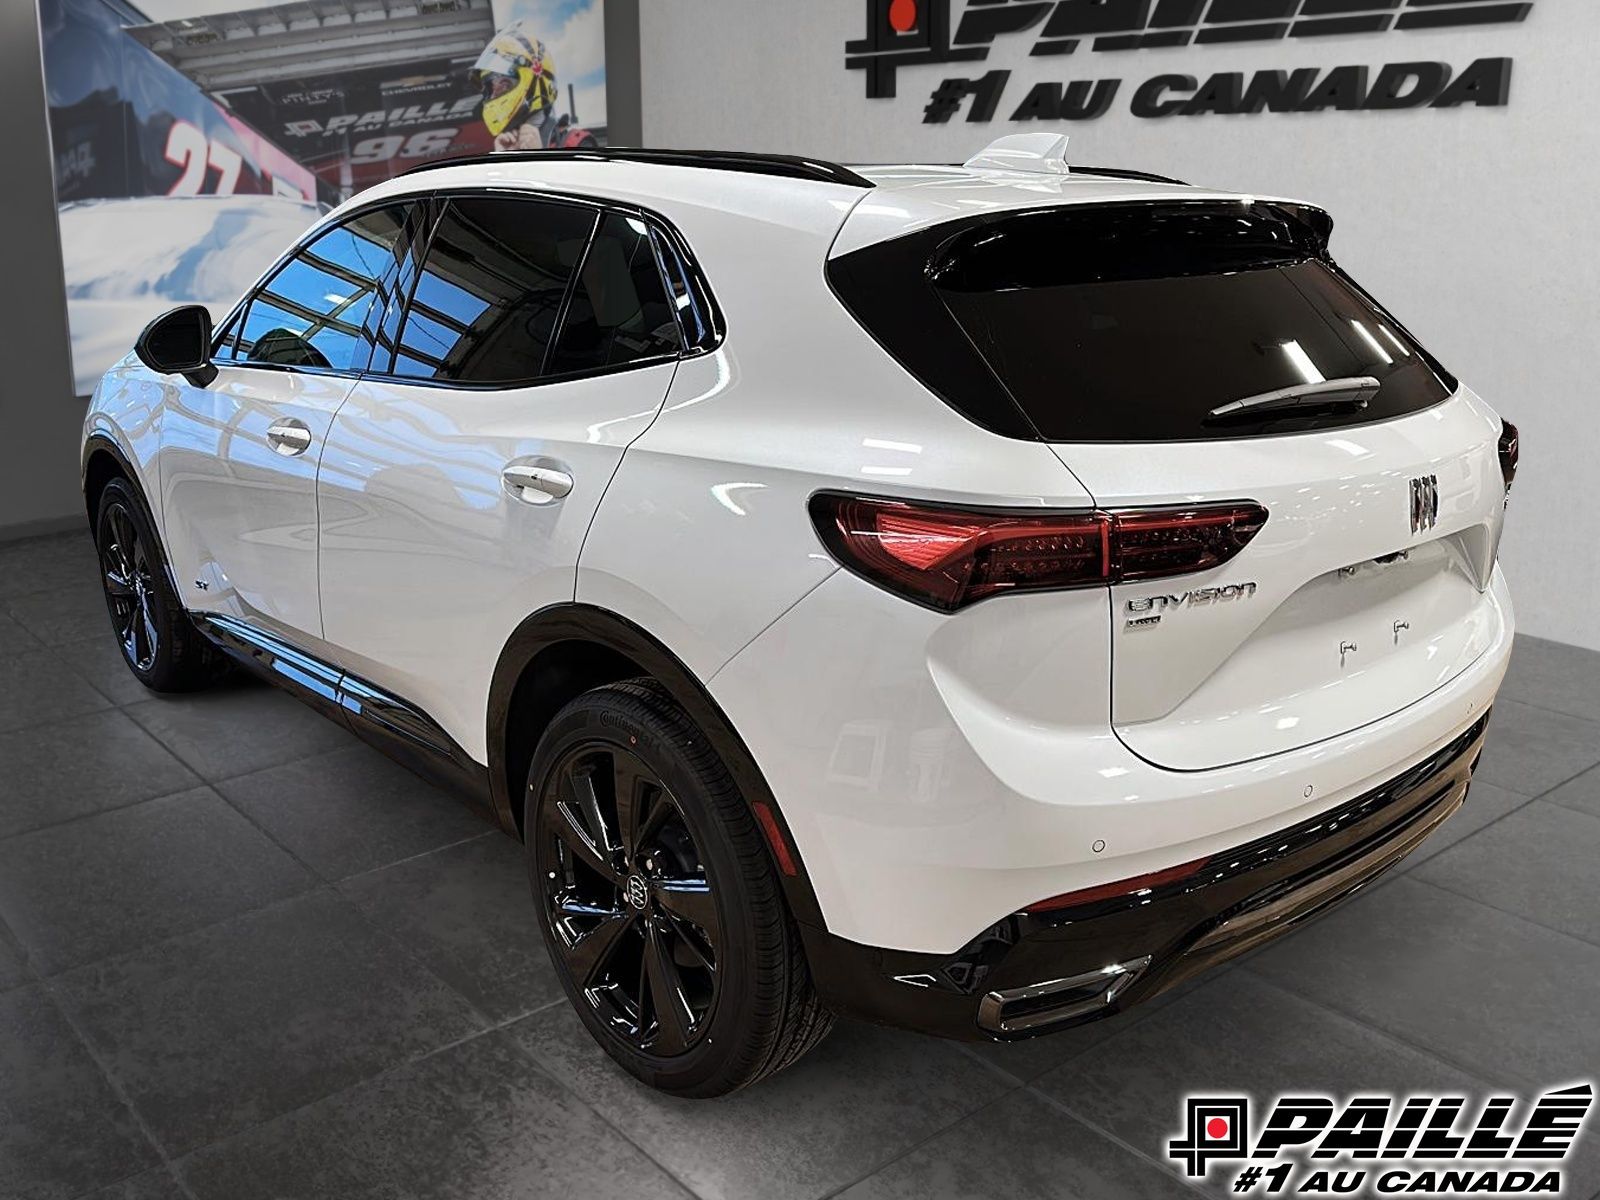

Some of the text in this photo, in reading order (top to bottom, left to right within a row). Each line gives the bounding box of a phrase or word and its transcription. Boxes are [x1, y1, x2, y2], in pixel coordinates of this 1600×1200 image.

[922, 57, 1513, 124] #1 AU CANADA
[163, 118, 243, 197] 27
[351, 128, 459, 165] 96
